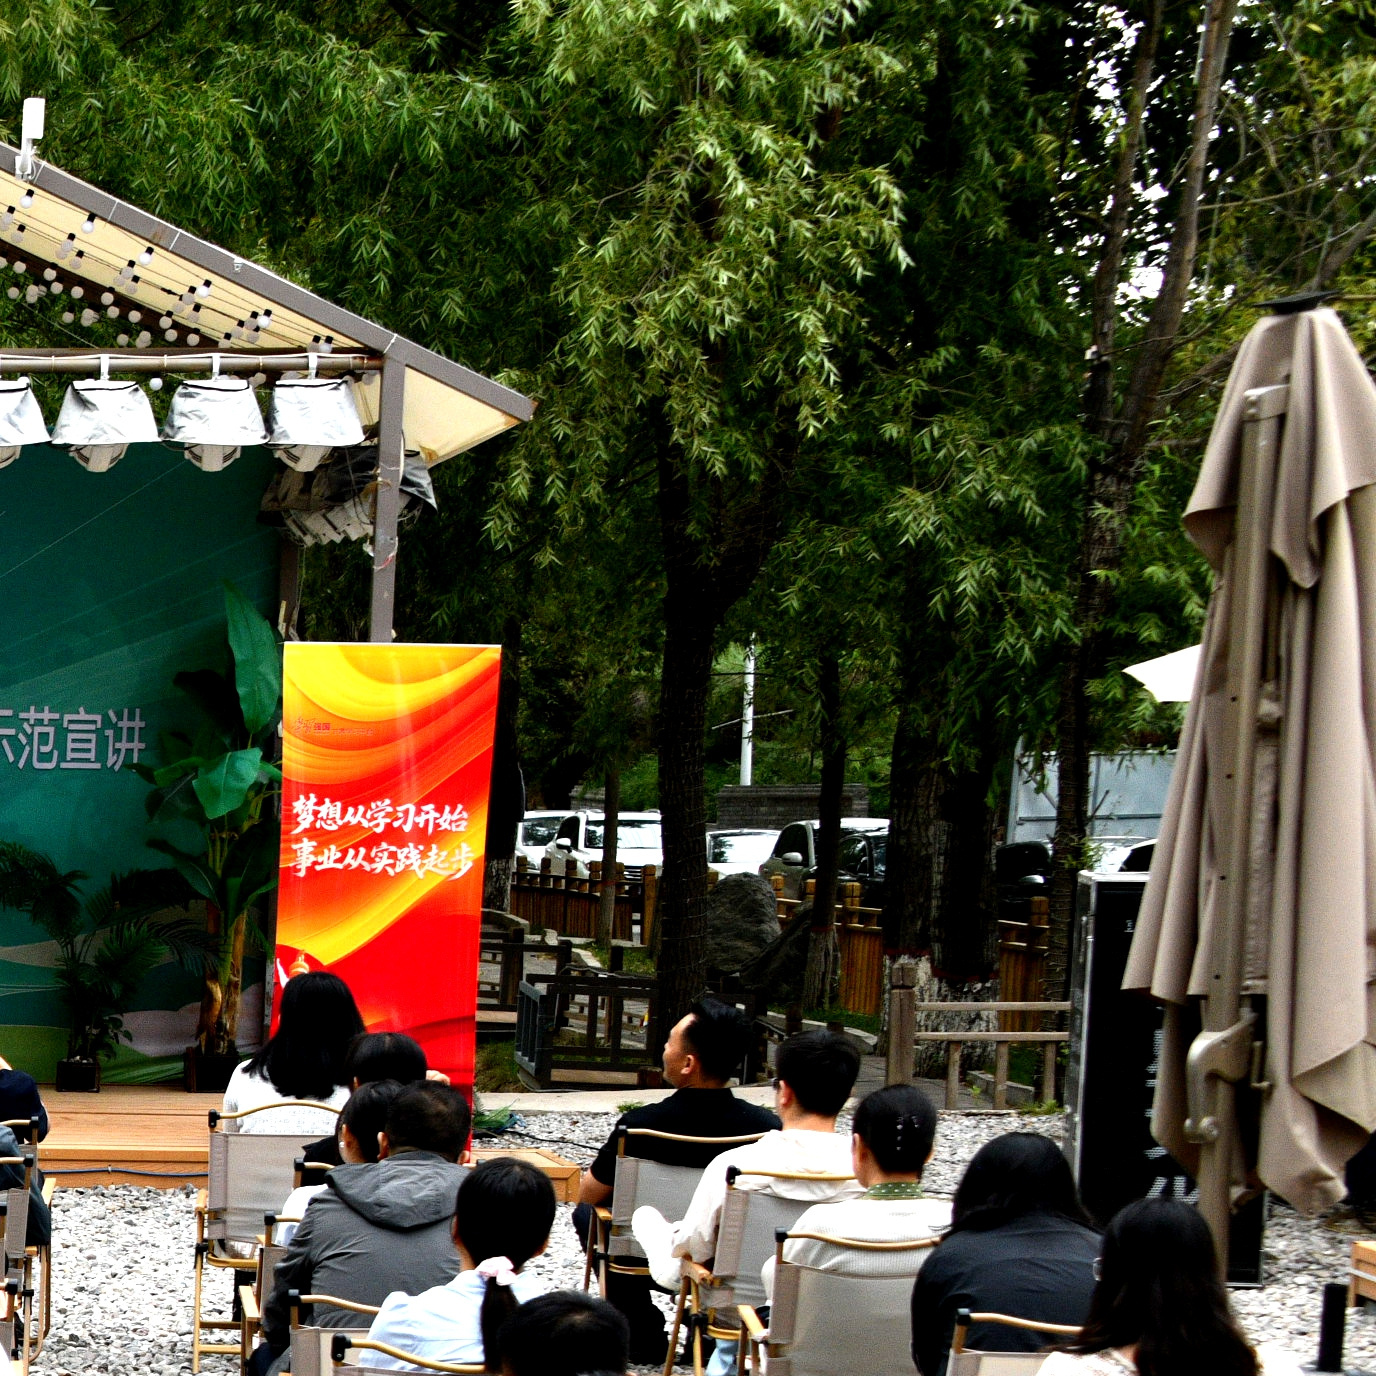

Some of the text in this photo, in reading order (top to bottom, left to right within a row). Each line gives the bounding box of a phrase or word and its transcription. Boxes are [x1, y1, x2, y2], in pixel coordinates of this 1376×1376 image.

[290, 793, 468, 836] 梦想从学习开始
[289, 836, 474, 880] 事业从实践起步
